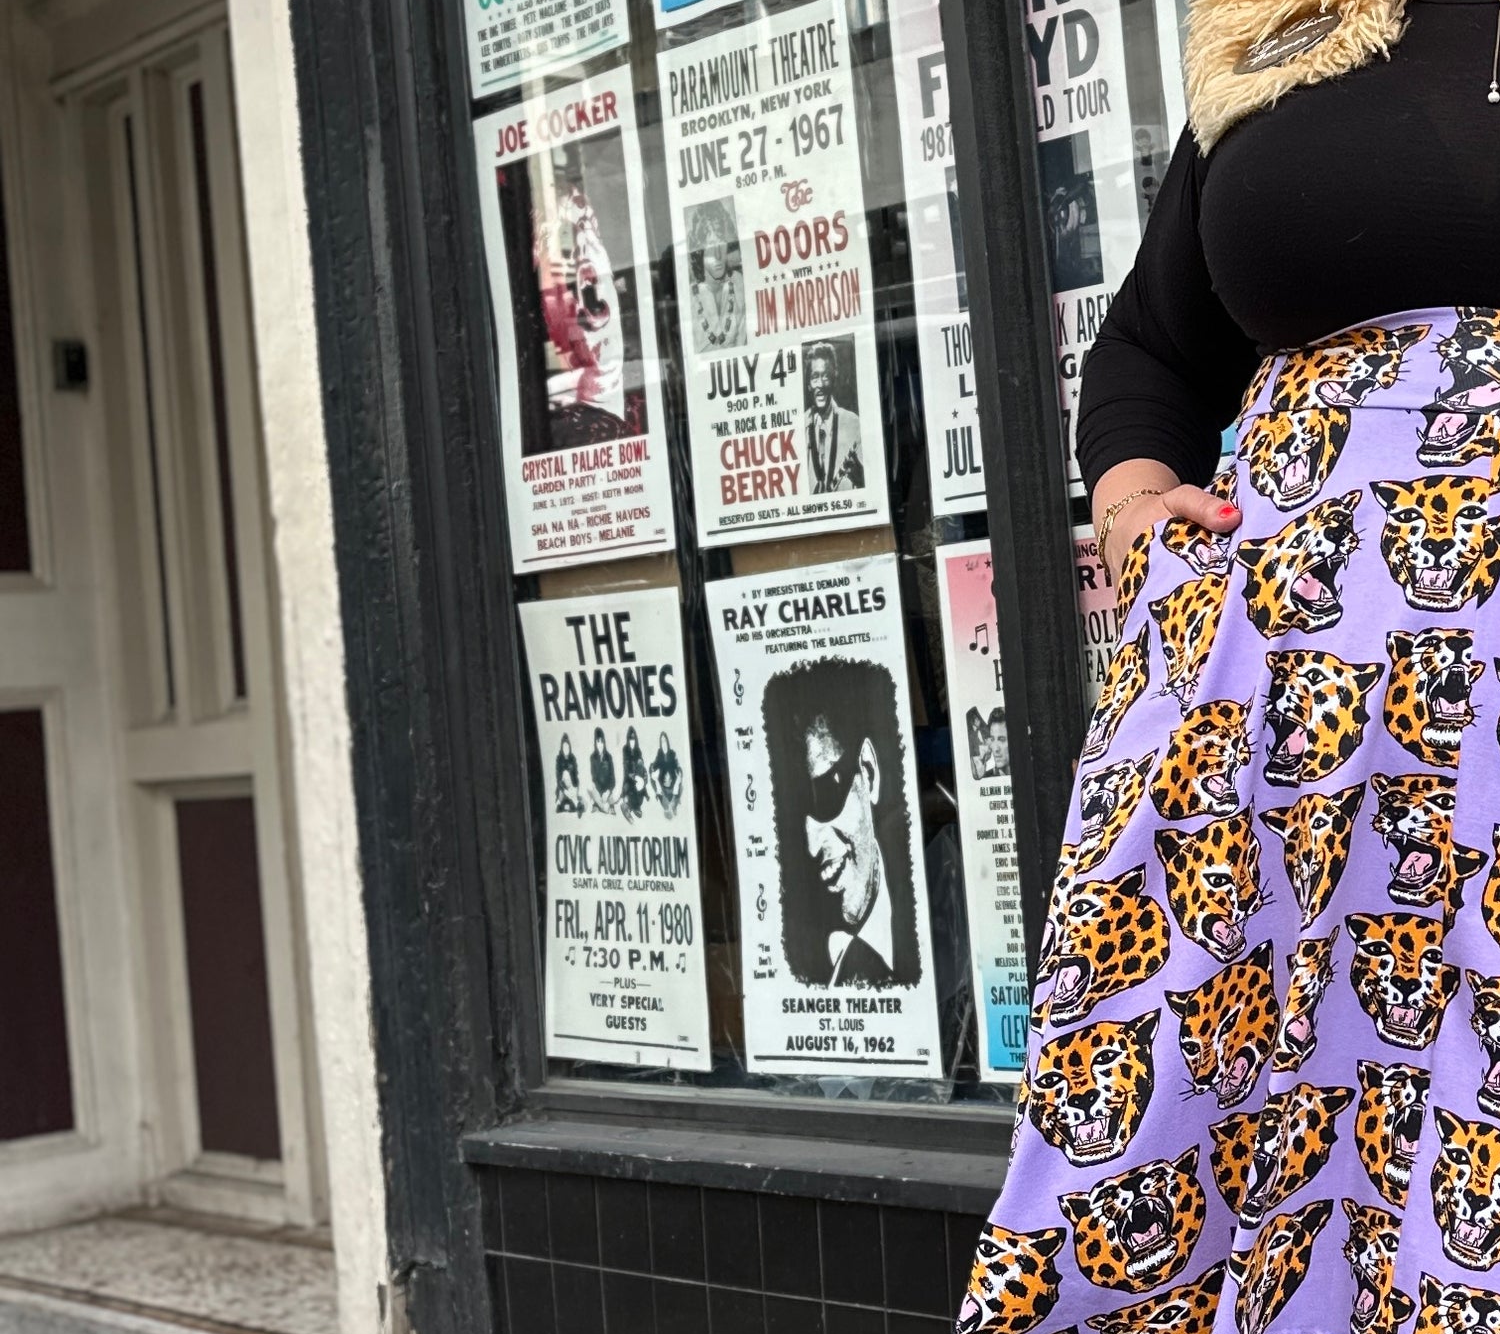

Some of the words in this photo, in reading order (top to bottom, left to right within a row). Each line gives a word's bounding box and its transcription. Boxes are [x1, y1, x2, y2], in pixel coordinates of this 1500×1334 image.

[670, 47, 757, 117] PARAMOUNT
[770, 20, 838, 85] THEATRE
[495, 119, 529, 157] JOE
[536, 91, 617, 147] COCKER
[680, 103, 756, 137] BROOKLYN,
[678, 140, 731, 187] JUNE
[740, 125, 767, 166] 27
[789, 104, 844, 158] 1967
[754, 211, 849, 269] DOORS
[755, 288, 778, 337] JIM
[785, 269, 861, 330] MORRISON
[707, 354, 756, 401] JULY
[770, 349, 797, 388] 4th
[522, 455, 567, 482] CRYSTAL
[572, 446, 614, 473] PALACE
[620, 439, 650, 465] BOWL
[720, 430, 798, 471] CHUCK
[721, 464, 800, 505] BERRY
[599, 525, 635, 542] MELANIE
[616, 507, 651, 522] HAVENS
[722, 600, 766, 631] RAY
[779, 587, 886, 625] CHARLES
[565, 611, 636, 666] THE
[540, 665, 677, 722] RAMONES
[556, 835, 593, 877] CIVIC
[598, 837, 689, 879] AUDITORIUM
[657, 906, 693, 946] 1980
[606, 1015, 647, 1031] GUESTS
[782, 998, 841, 1015] SEANGER
[846, 998, 902, 1014] THEATER
[786, 1036, 837, 1052] AUGUST
[863, 1036, 895, 1052] 1962
